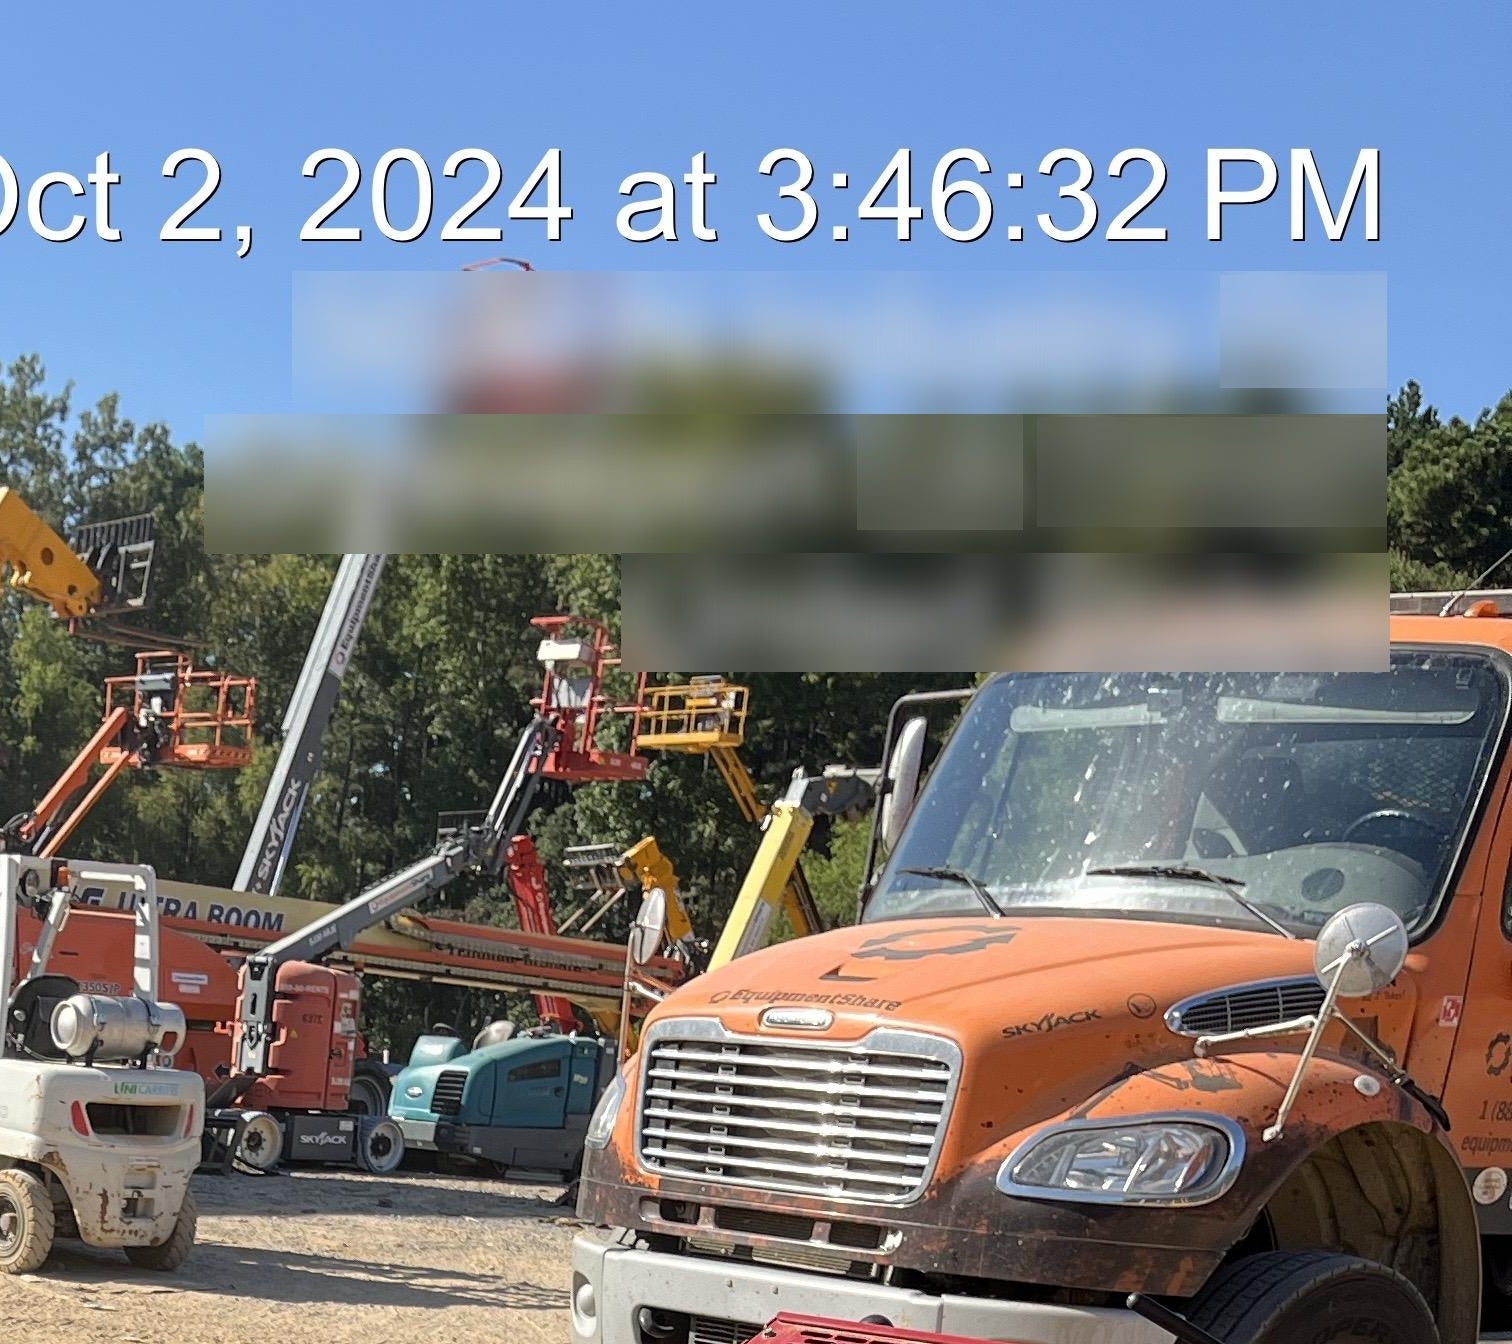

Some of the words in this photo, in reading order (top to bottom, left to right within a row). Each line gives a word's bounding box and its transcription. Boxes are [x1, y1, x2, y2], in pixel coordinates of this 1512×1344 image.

[257, 778, 302, 881] SKYJACK
[207, 902, 284, 933] BOOM
[731, 988, 903, 1012] EquipmentShare
[1002, 1009, 1103, 1039] SKYJACK
[299, 1131, 347, 1147] SKYJACK
